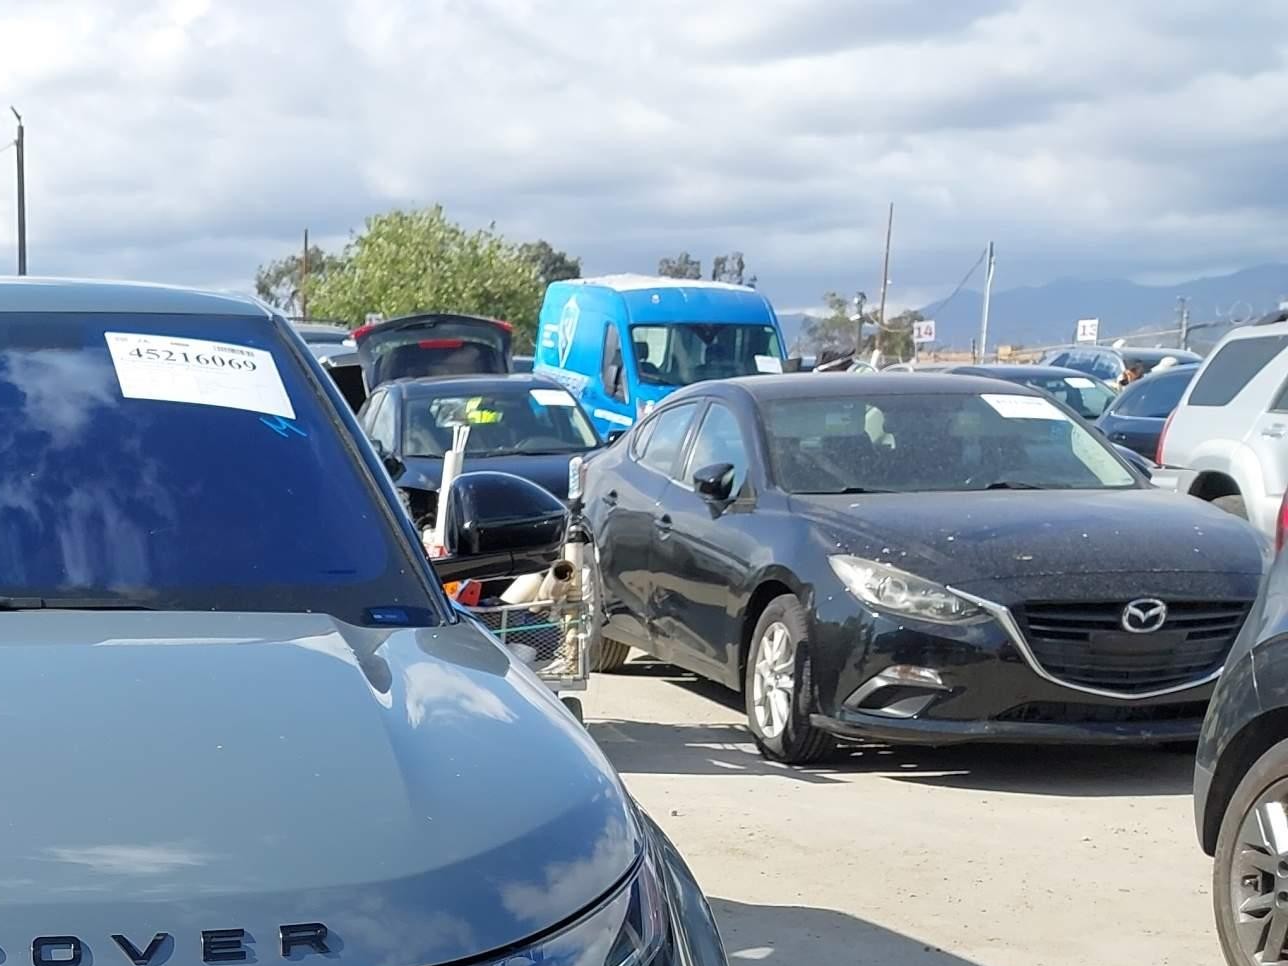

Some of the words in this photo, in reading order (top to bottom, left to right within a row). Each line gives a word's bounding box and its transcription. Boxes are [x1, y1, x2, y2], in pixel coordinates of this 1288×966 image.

[916, 325, 933, 338] 14
[1079, 324, 1096, 336] 13
[129, 347, 256, 371] 45216069
